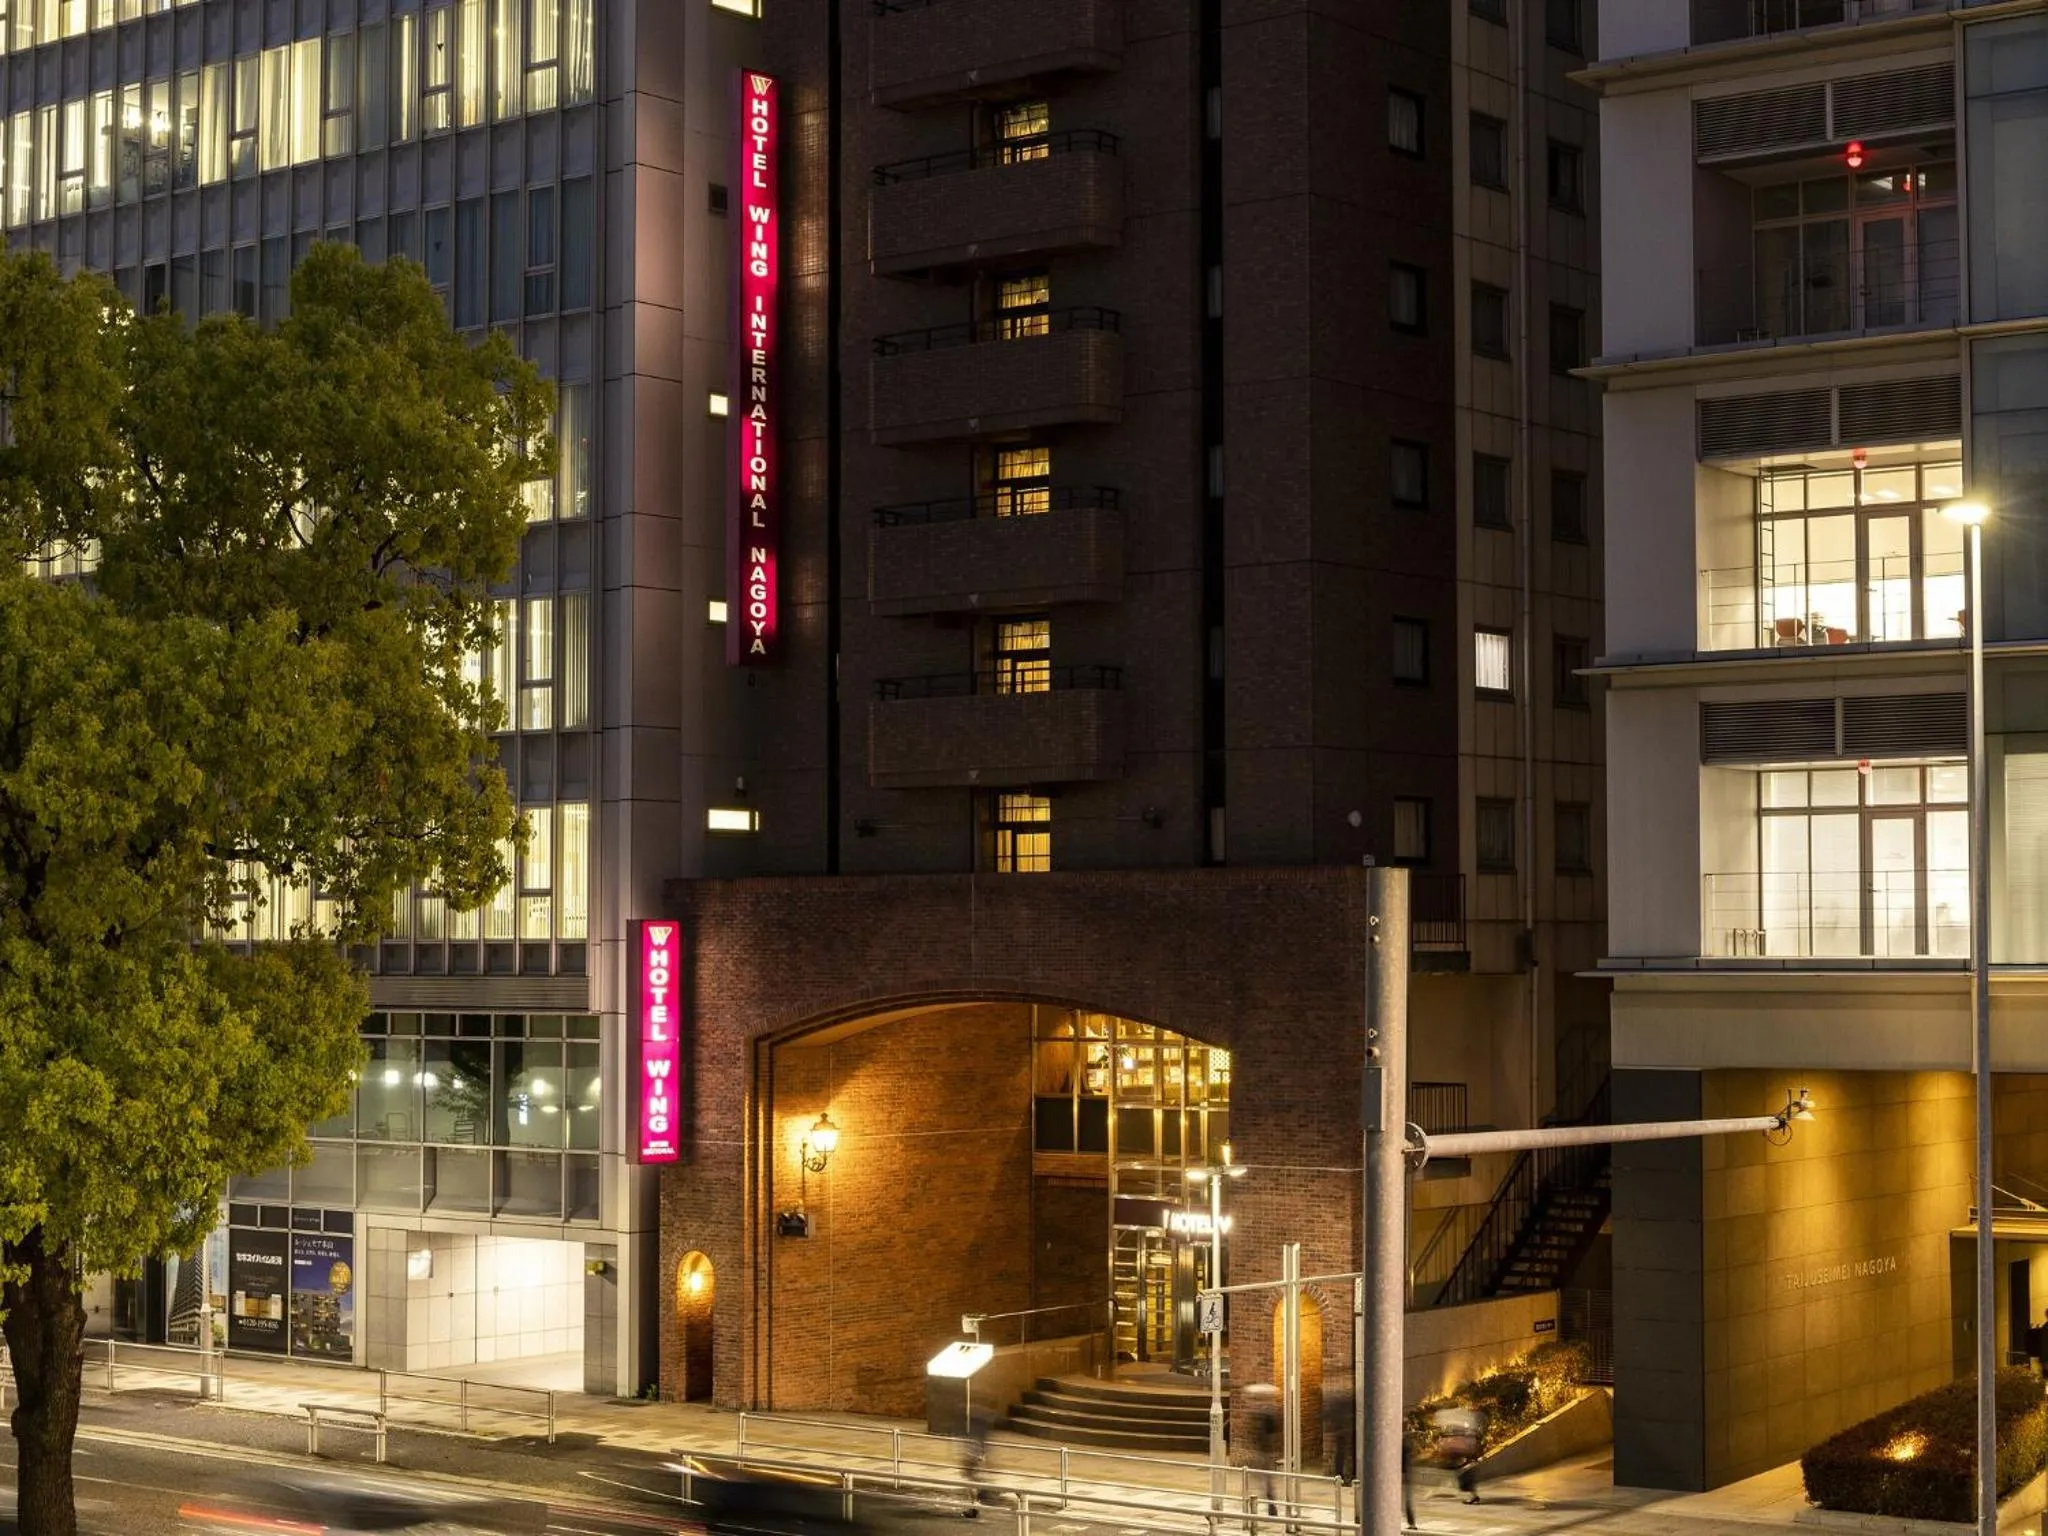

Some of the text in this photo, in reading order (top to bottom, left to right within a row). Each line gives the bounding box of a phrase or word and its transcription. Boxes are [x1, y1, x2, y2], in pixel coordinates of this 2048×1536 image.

[751, 98, 769, 188] HOTEL
[749, 205, 770, 277] WING
[750, 296, 767, 528] INTERNATIONAL
[750, 547, 767, 654] NAGOYA
[648, 950, 669, 1041] HOTEL
[646, 1060, 672, 1132] WING
[1855, 1256, 1897, 1277] NAGOYA
